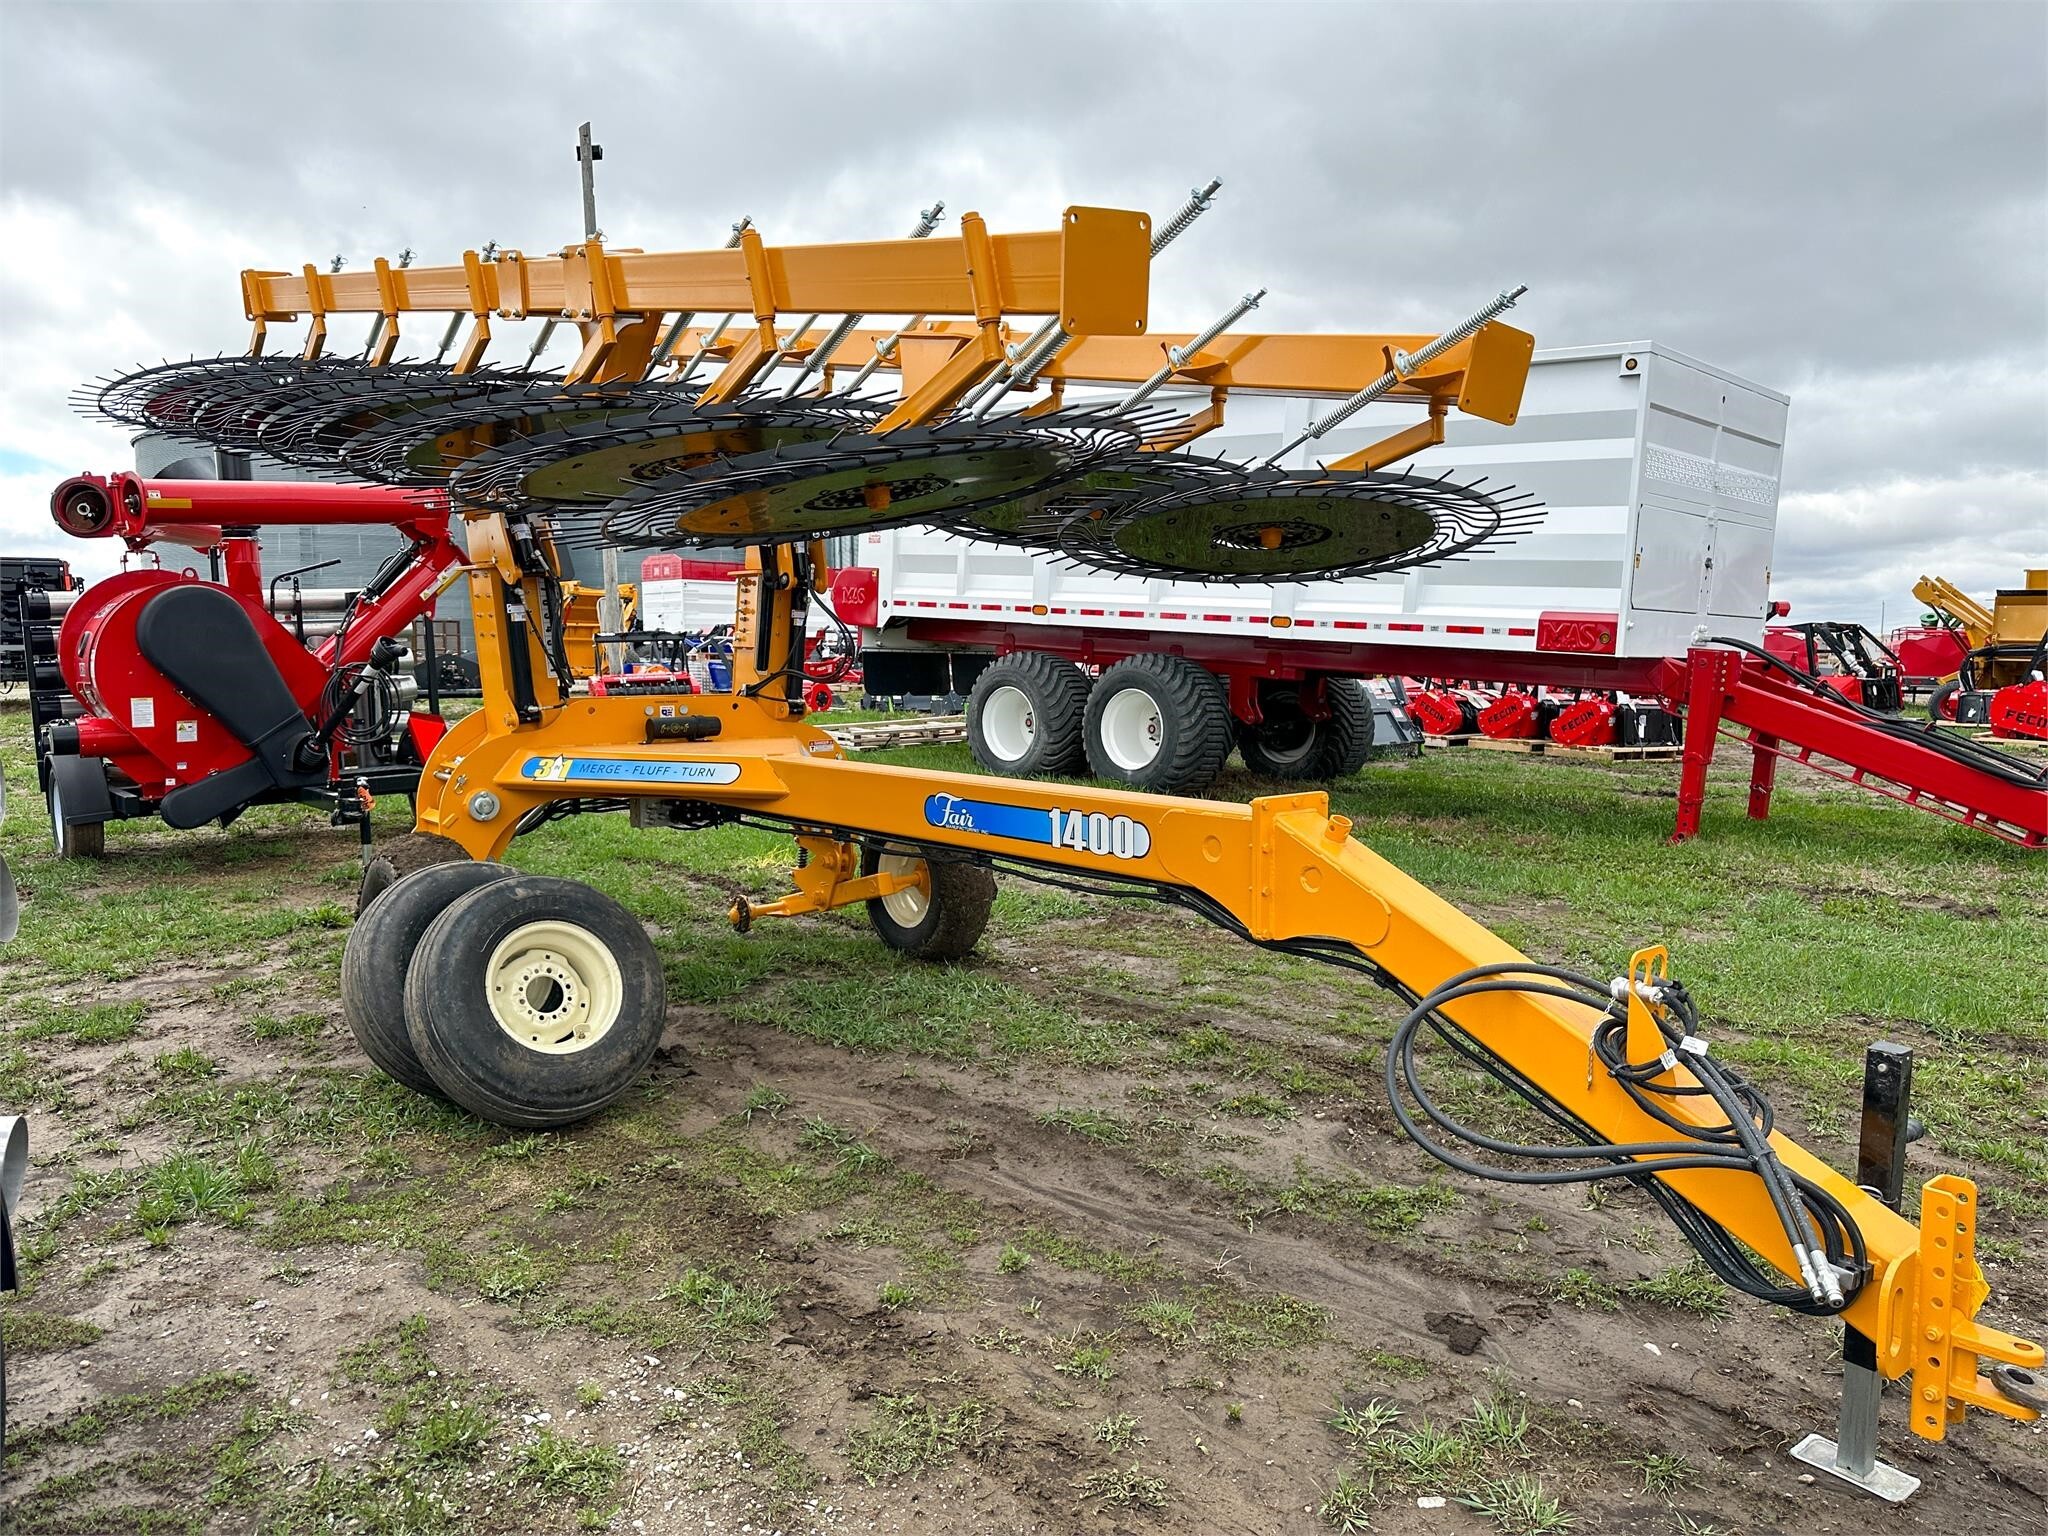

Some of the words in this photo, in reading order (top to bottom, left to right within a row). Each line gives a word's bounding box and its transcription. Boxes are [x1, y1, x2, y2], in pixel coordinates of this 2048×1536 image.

[1542, 621, 1596, 648] MAS
[1420, 702, 1445, 723] FECON
[1487, 704, 1519, 724] FECON
[1561, 710, 1595, 733] FECON
[579, 763, 622, 775] MERGE
[632, 765, 671, 776] FLUFF
[682, 767, 717, 778] TURN
[933, 792, 975, 828] Fair
[1048, 806, 1135, 860] 1400
